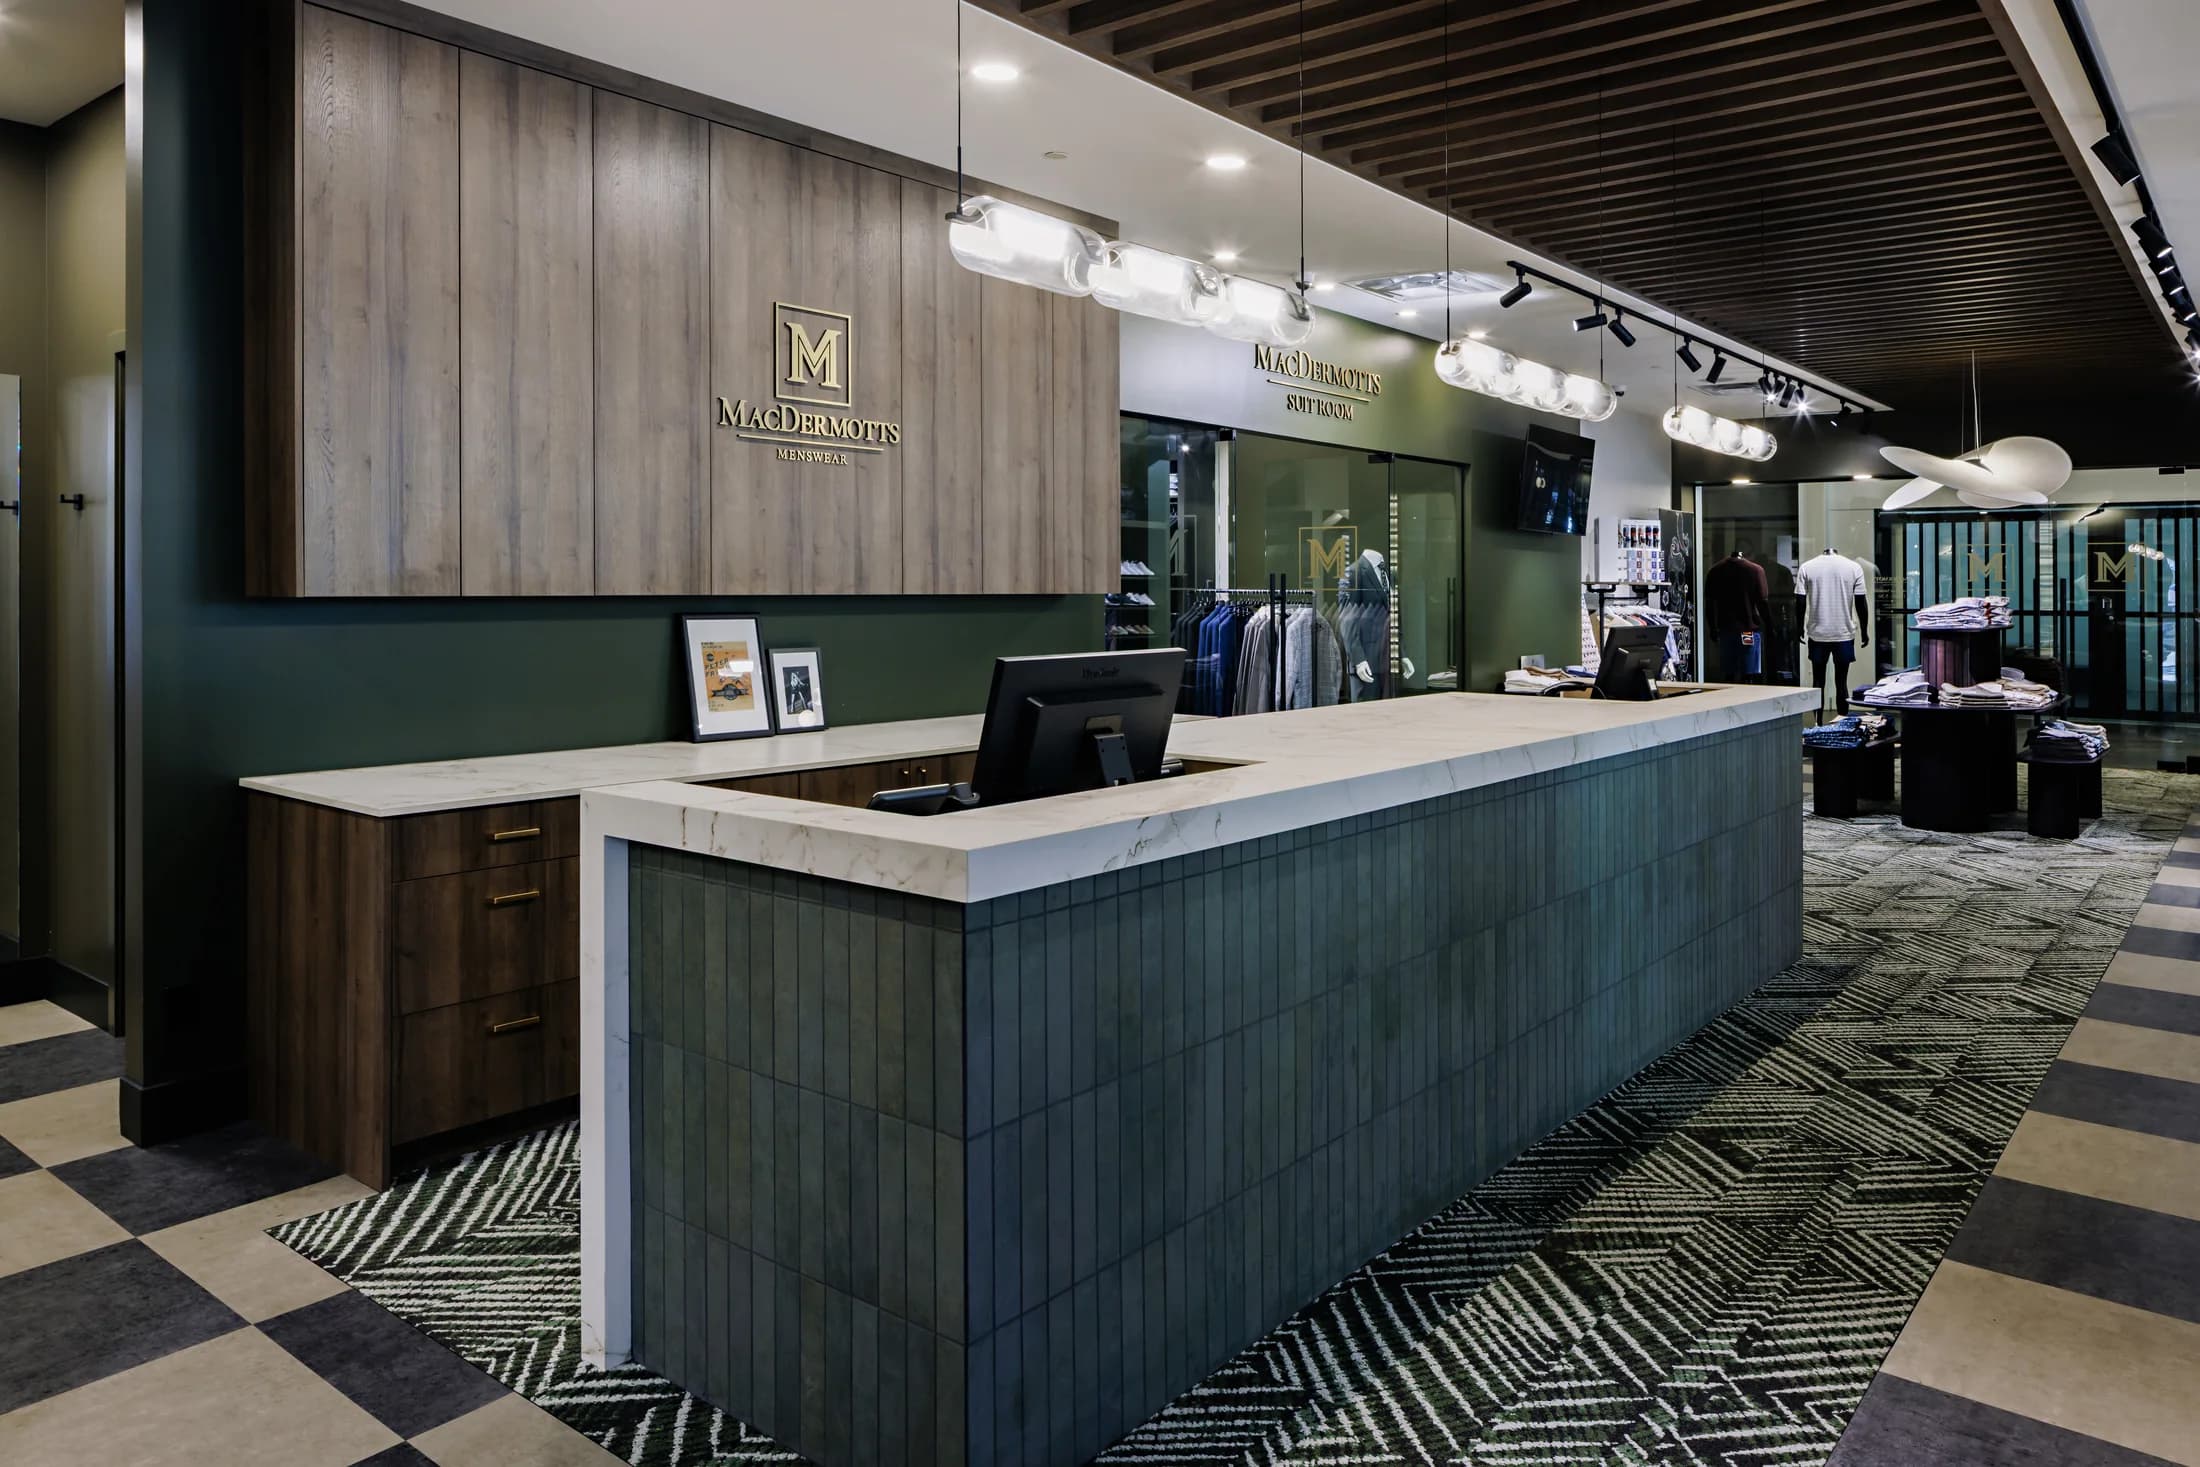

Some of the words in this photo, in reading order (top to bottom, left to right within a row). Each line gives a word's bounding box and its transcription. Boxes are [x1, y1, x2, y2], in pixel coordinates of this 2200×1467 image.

[785, 322, 842, 389] M
[1254, 343, 1382, 396] MACDERMOTTS
[718, 397, 900, 444] MACDERMOTTS
[1287, 393, 1315, 414] SUIT
[1317, 398, 1354, 421] ROOM
[777, 448, 848, 466] MENSWEAR
[1305, 536, 1347, 579] M
[1967, 552, 2007, 583] M
[2094, 551, 2137, 583] M
